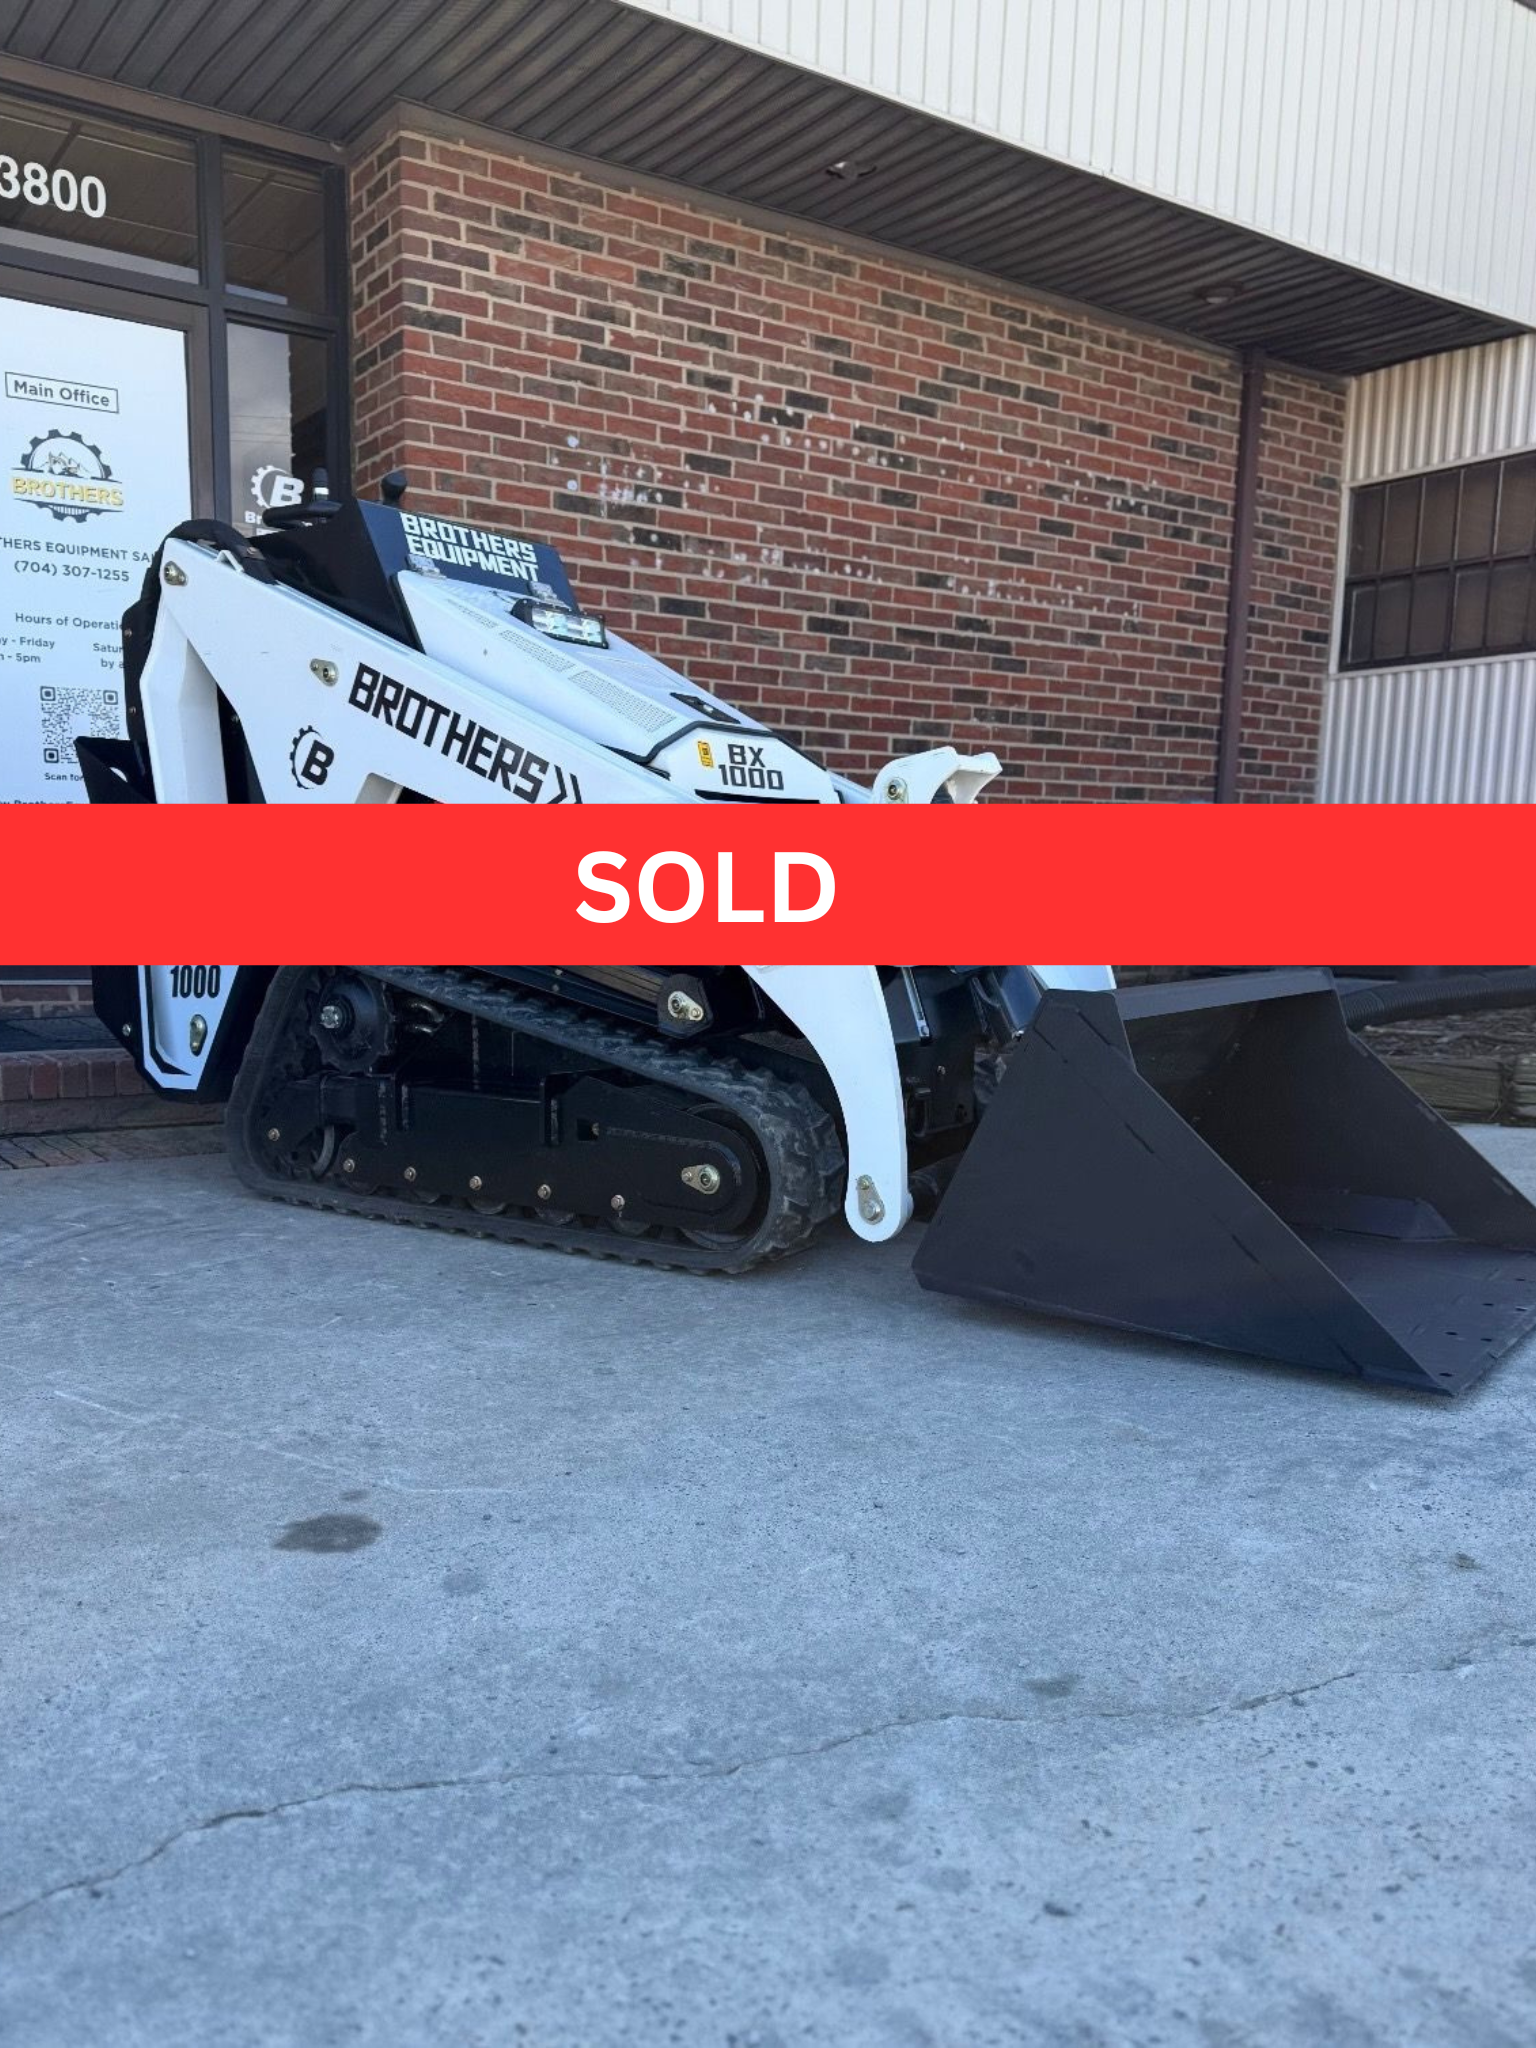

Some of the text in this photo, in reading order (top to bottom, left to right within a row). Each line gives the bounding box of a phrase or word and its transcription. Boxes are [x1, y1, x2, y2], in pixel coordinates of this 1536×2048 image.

[0, 154, 107, 218] 3800
[14, 379, 110, 407] Main Office
[12, 476, 125, 507] BROTHERS
[0, 536, 41, 551] HERS
[46, 541, 128, 561] EQUIPMENT
[400, 511, 538, 563] BROTHERS
[405, 533, 539, 582] EQUIPMENT
[14, 560, 130, 582] (704) 307-1255
[15, 612, 52, 625] Hours
[56, 616, 69, 627] of
[19, 636, 56, 650] Friday
[92, 642, 124, 654] Satur
[15, 652, 42, 664] 5pm
[101, 658, 115, 670] by
[348, 662, 550, 804] BROTHERS
[301, 739, 335, 786] B
[727, 743, 766, 768] BX
[44, 772, 68, 781] Scan
[718, 764, 784, 791] 1000
[170, 965, 221, 999] 1000
